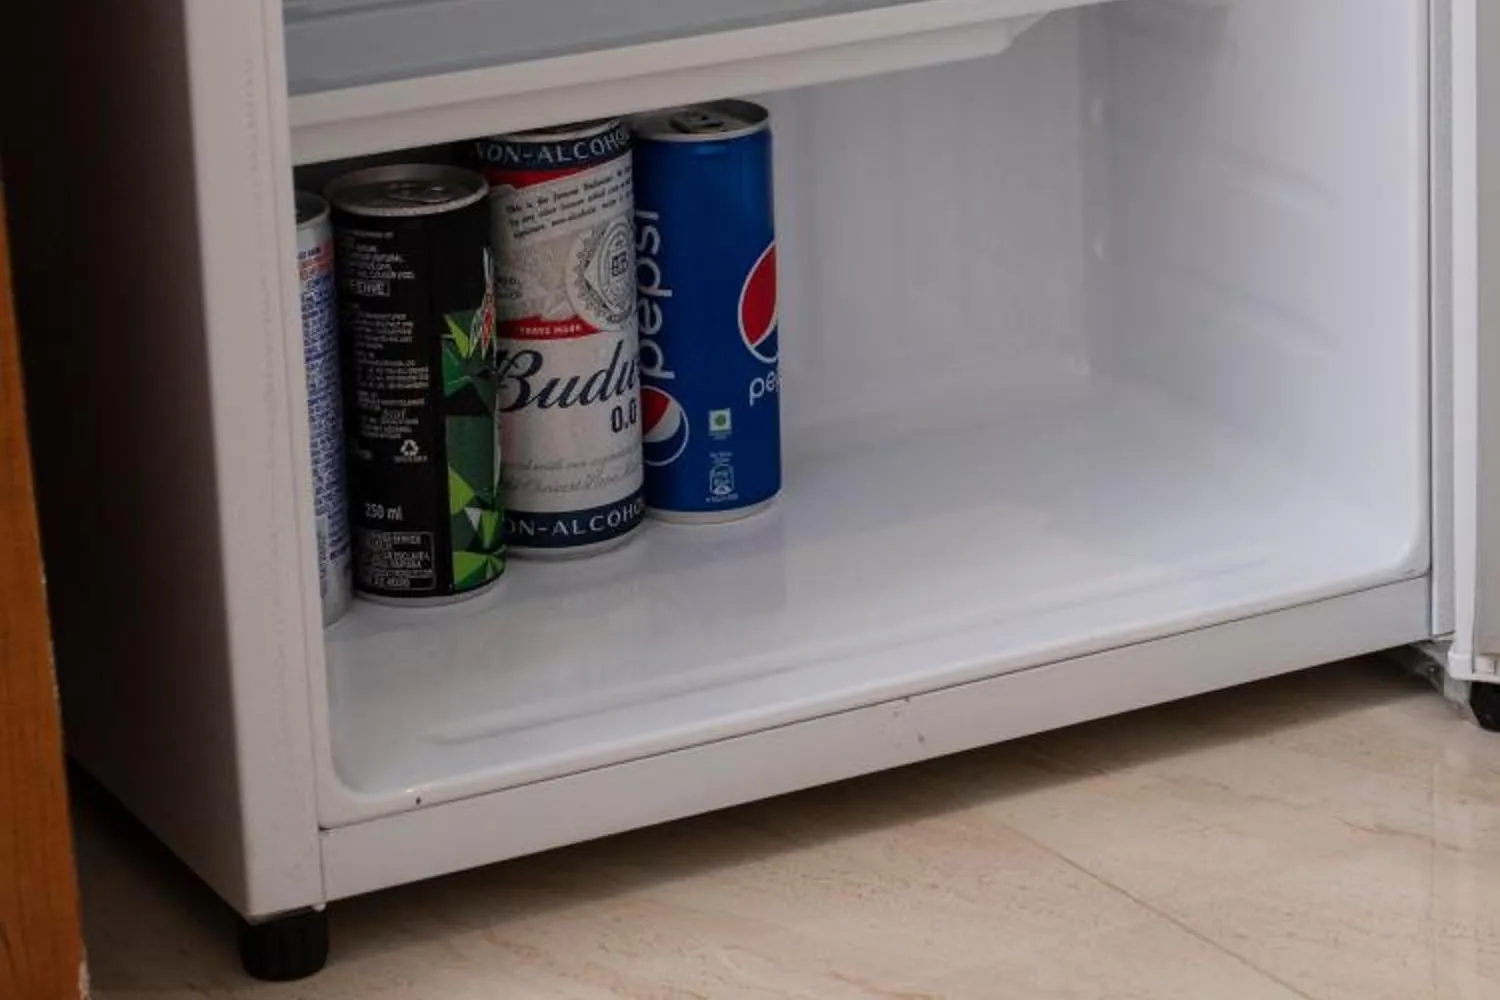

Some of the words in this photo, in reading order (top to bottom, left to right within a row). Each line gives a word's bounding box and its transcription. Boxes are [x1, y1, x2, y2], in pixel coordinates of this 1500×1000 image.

[637, 210, 676, 380] pepsi
[748, 370, 779, 407] pe
[611, 397, 637, 433] 0.0
[387, 504, 404, 521] ml
